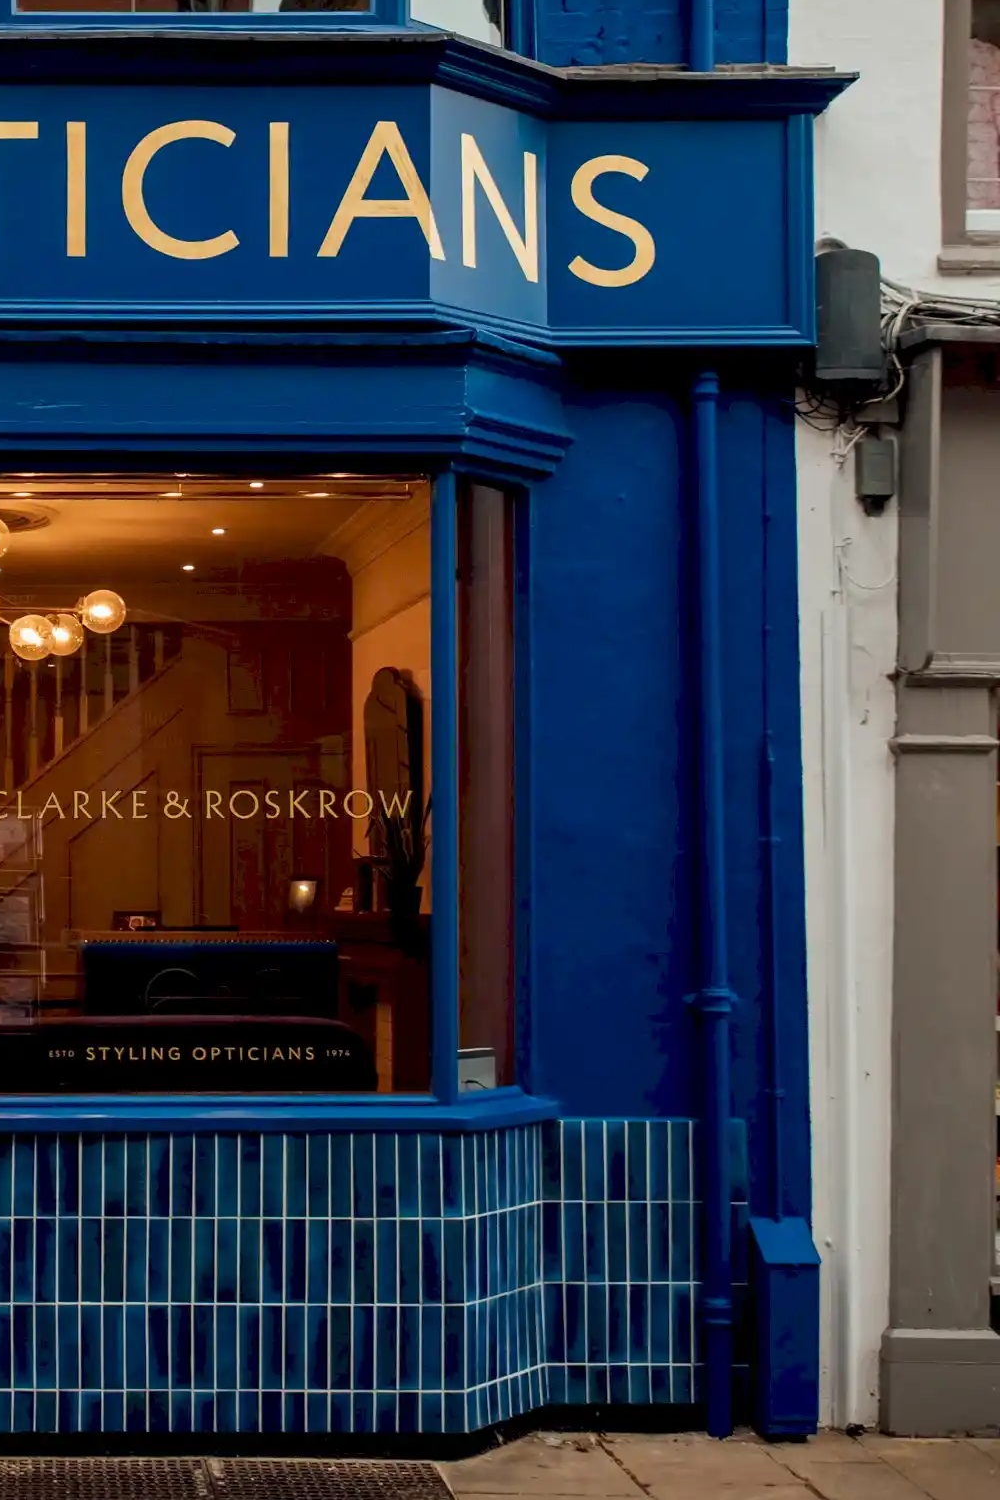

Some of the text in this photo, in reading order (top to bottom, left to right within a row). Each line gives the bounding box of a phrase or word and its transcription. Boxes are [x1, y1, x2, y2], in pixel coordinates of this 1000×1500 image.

[163, 790, 192, 820] &
[205, 790, 414, 820] ROSKROW
[86, 1047, 181, 1061] STYLING
[192, 1047, 316, 1061] OPTICIANS
